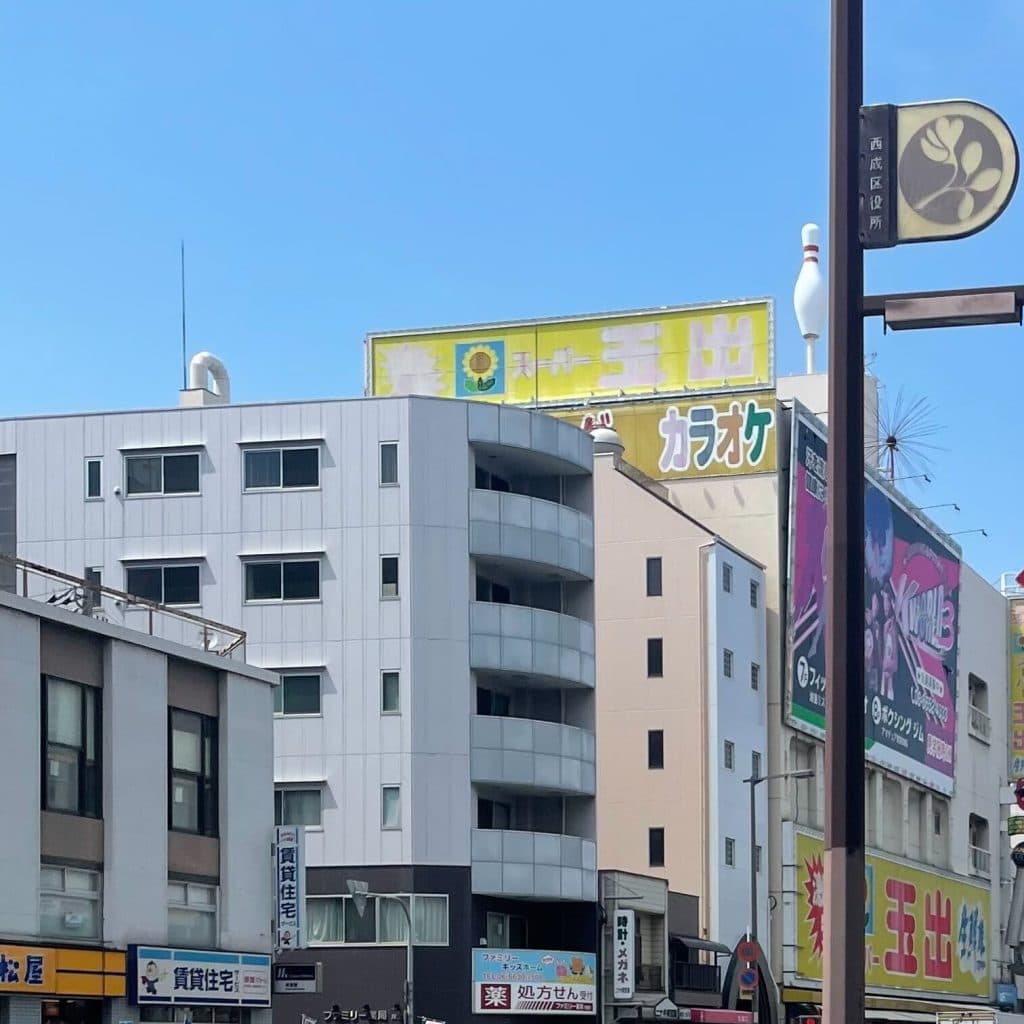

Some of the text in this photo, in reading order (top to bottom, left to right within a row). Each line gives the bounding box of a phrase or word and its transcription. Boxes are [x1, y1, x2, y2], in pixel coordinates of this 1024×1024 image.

[869, 136, 884, 231] 西成区役所
[658, 400, 774, 474] カラオケ
[280, 847, 297, 919] 賃貸住宅
[0, 953, 43, 985] 松屋
[173, 966, 233, 993] 賃貸住宅
[617, 915, 629, 983] 時計・メガネ
[484, 985, 508, 1007] 薬
